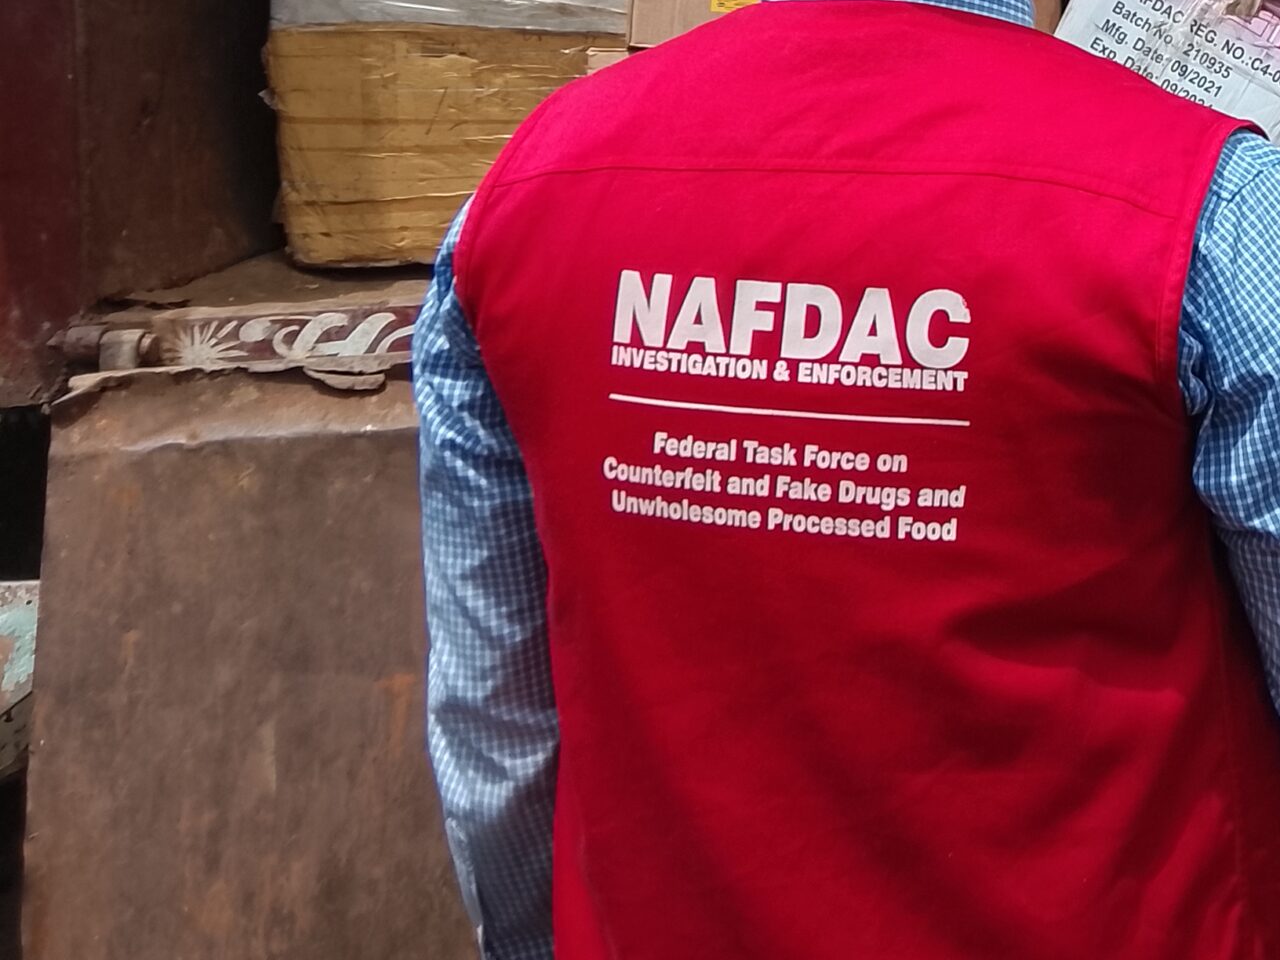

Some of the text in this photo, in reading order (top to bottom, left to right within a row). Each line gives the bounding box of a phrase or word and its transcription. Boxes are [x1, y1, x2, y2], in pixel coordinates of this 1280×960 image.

[1101, 18, 1224, 98] Mfg. Date: 09/2021
[1112, 1, 1152, 34] Batch
[1182, 43, 1234, 80] 210935
[1123, 54, 1159, 84] Date:
[613, 268, 971, 369] NAFDAC
[611, 345, 969, 392] INVESTIGATION & ENFORCEMENT
[653, 431, 908, 473] Federal Task Force on
[603, 456, 966, 511] Counterfeit and Fake Drugs and
[611, 489, 957, 541] Unwholesome Processed Food
